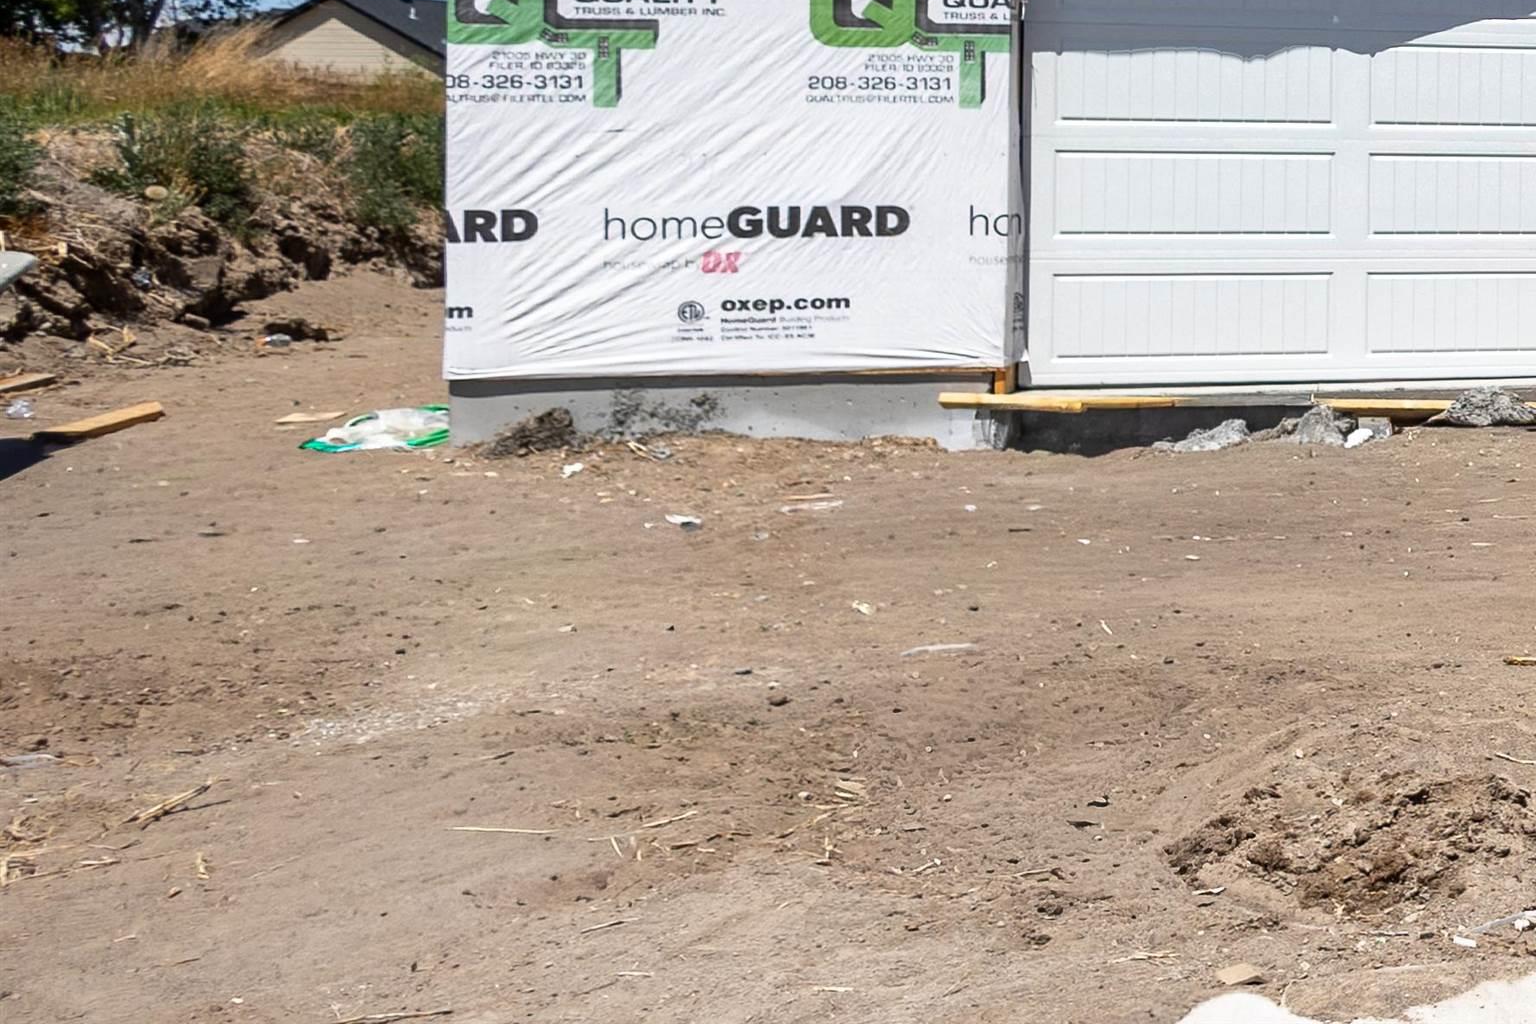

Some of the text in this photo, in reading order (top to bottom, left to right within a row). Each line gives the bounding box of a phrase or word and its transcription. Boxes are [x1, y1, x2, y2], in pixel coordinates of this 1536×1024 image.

[573, 6, 621, 16] TRUSS
[639, 7, 697, 17] LUMBER
[807, 75, 952, 91] 208-326-3131
[604, 205, 911, 241] homeGUARD
[701, 250, 742, 274] OX
[720, 296, 850, 314] oxep.com
